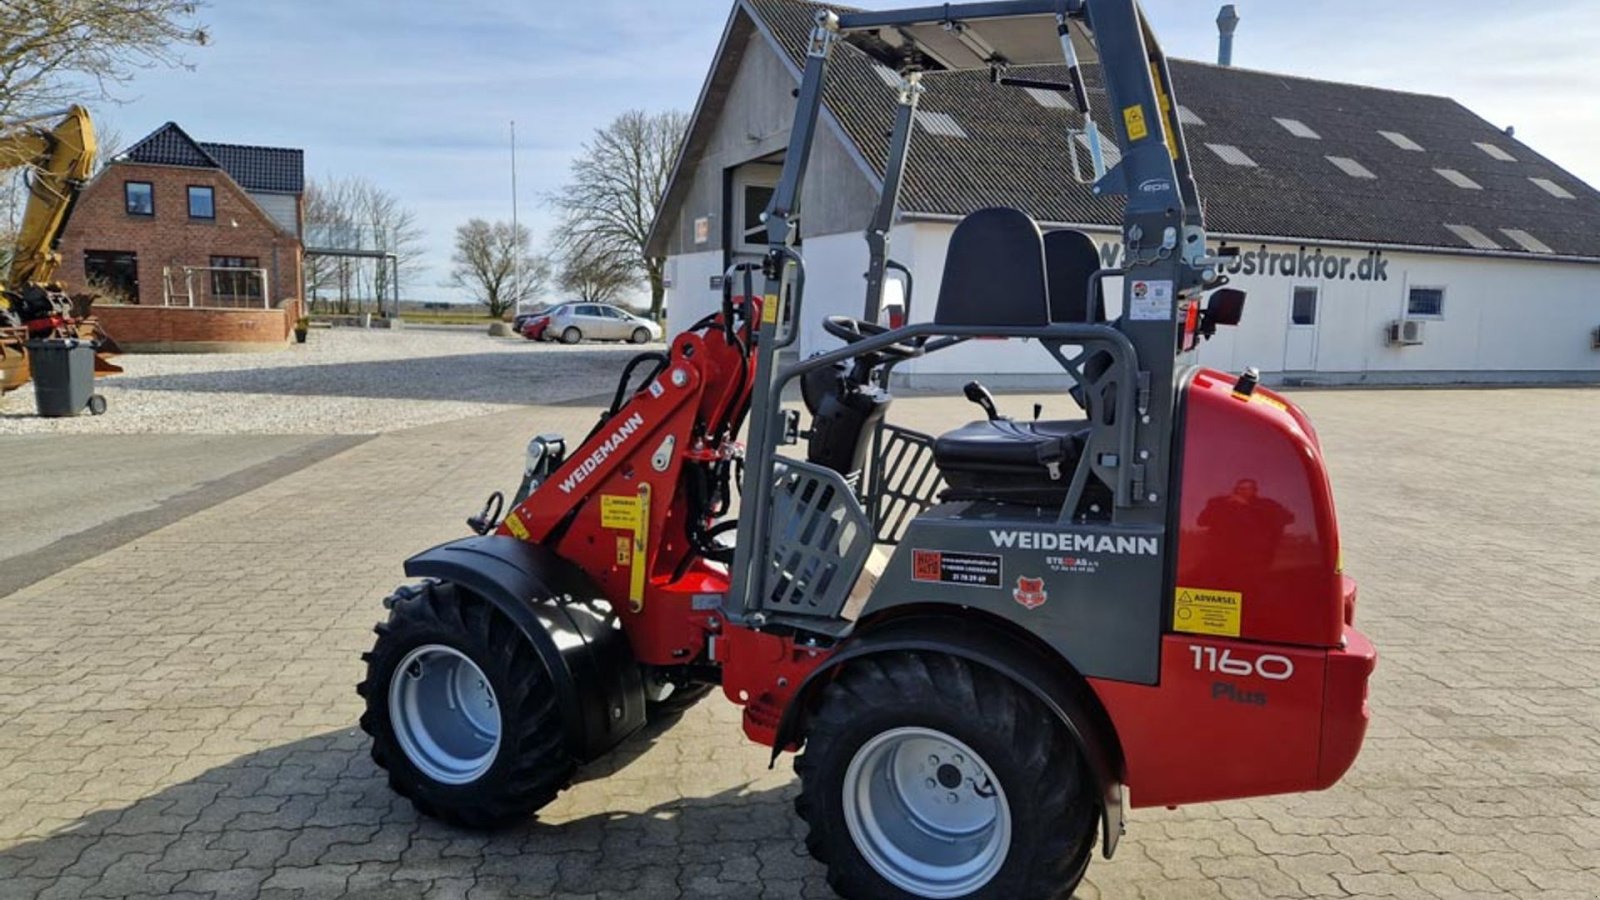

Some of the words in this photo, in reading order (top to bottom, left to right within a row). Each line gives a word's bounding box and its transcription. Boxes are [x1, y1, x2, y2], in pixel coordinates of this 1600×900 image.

[1143, 182, 1170, 193] eps
[558, 412, 644, 494] WEIDEMANN
[989, 530, 1158, 555] WEIDEMANN
[1194, 593, 1237, 605] ADVARSEL
[1188, 645, 1295, 681] 1160
[1211, 681, 1267, 707] Plus
